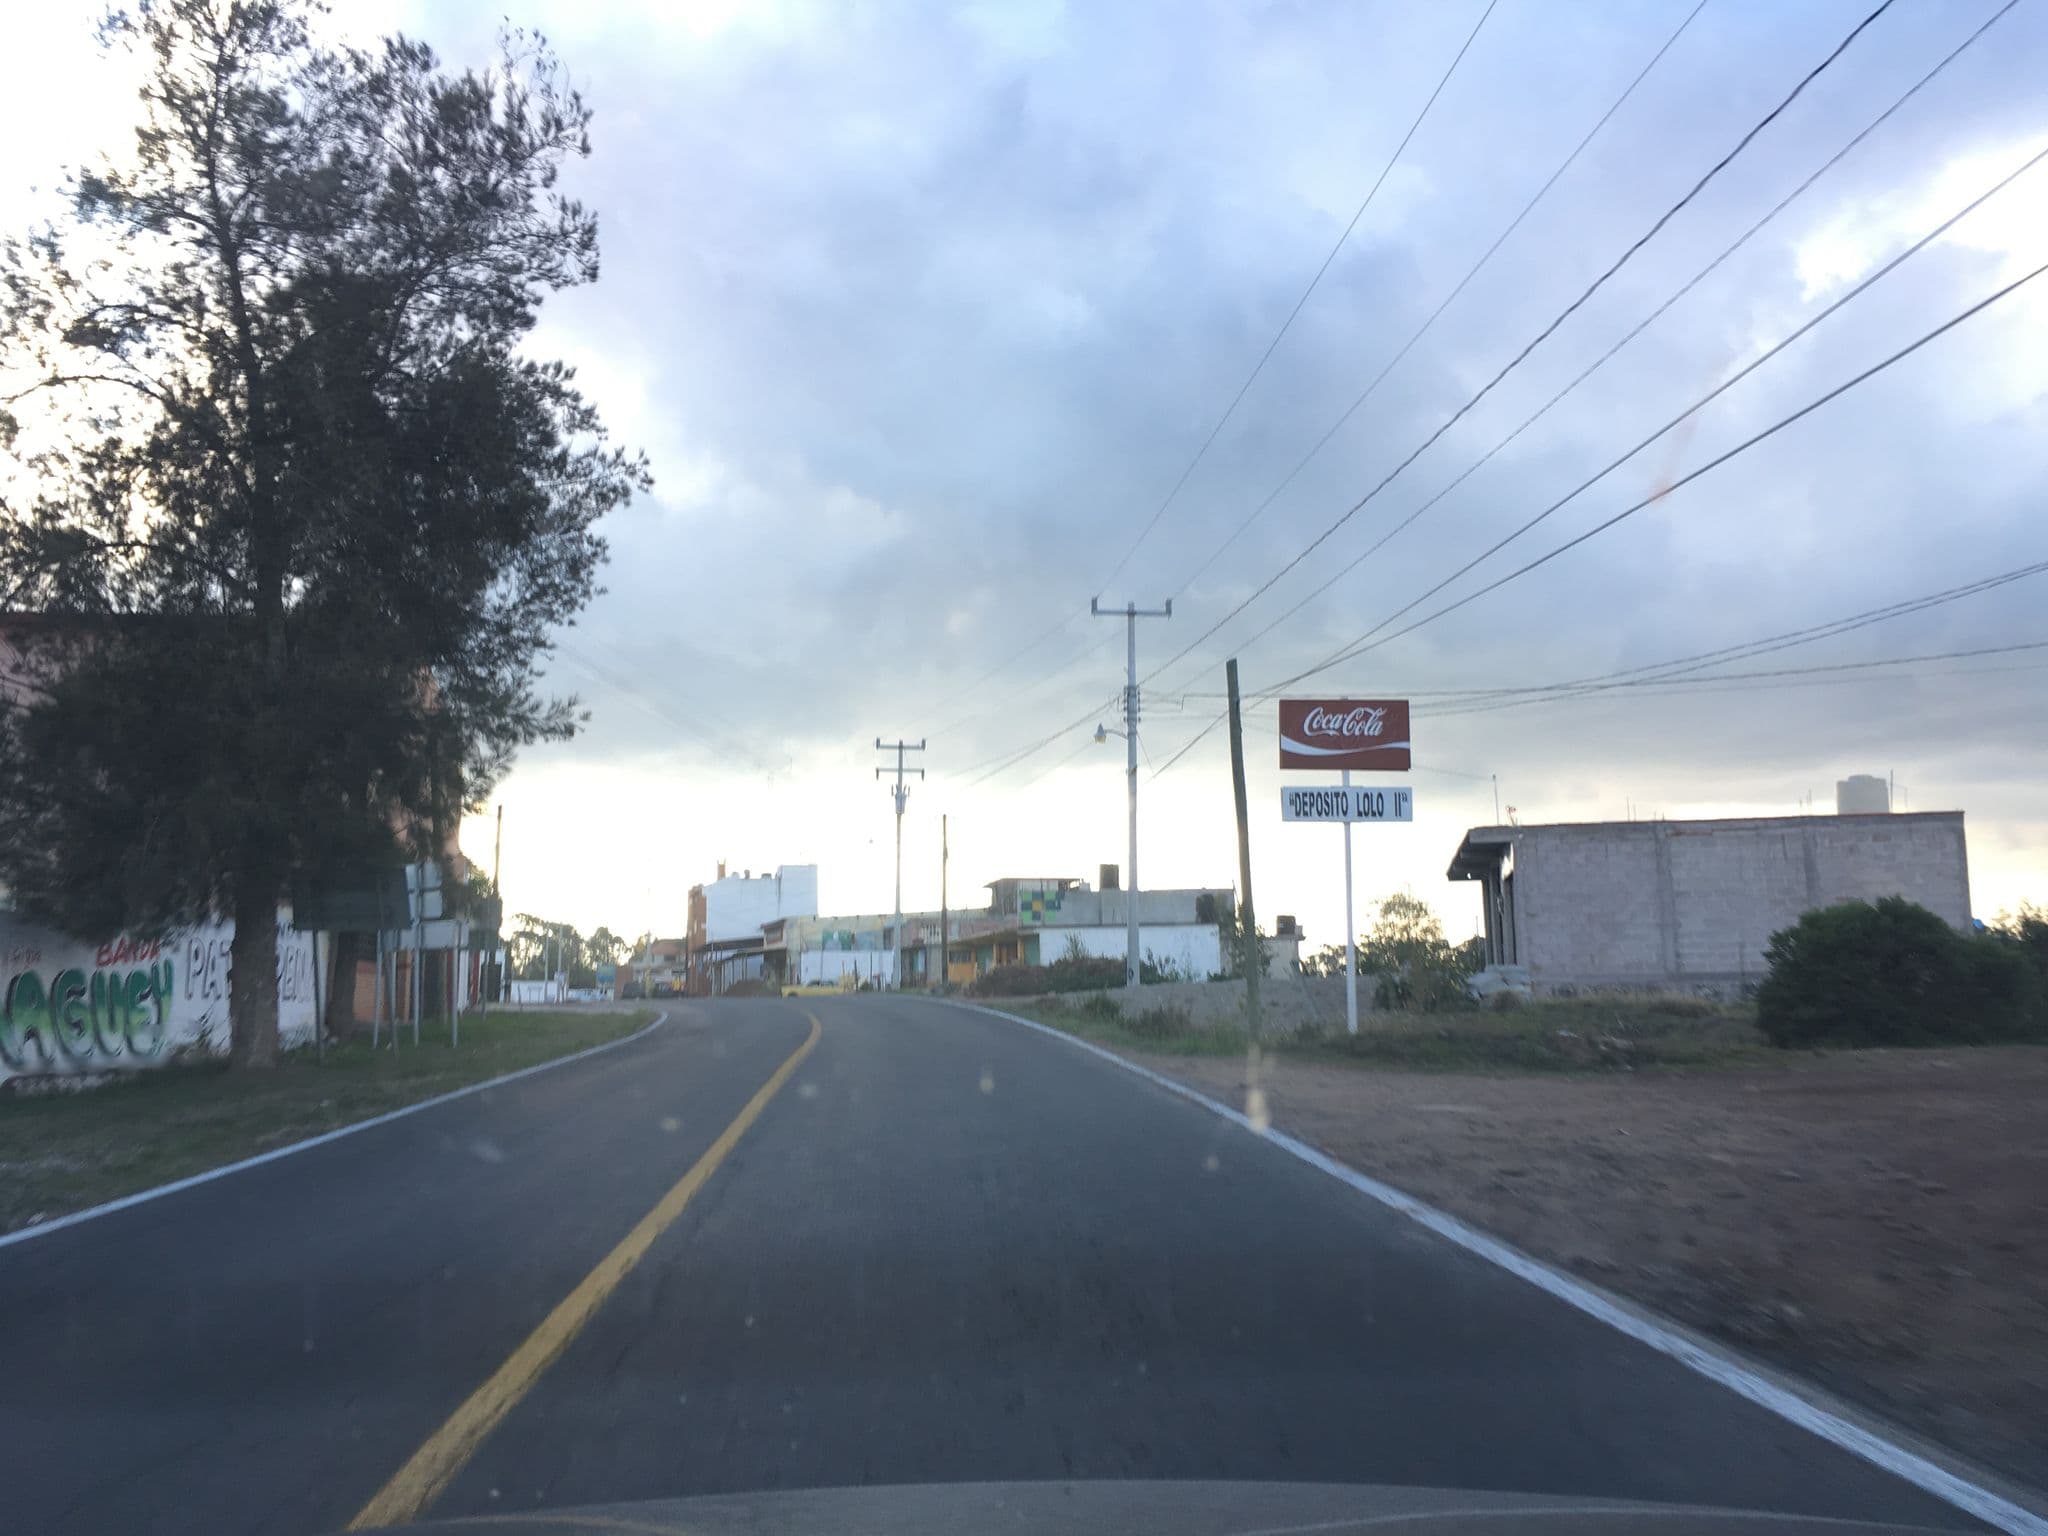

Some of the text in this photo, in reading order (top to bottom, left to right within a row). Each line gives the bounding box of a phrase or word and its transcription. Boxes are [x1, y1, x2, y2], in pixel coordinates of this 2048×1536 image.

[1303, 706, 1387, 736] Coca-Cola
[1356, 791, 1385, 817] LOLO
[0, 959, 174, 1068] AGUEY
